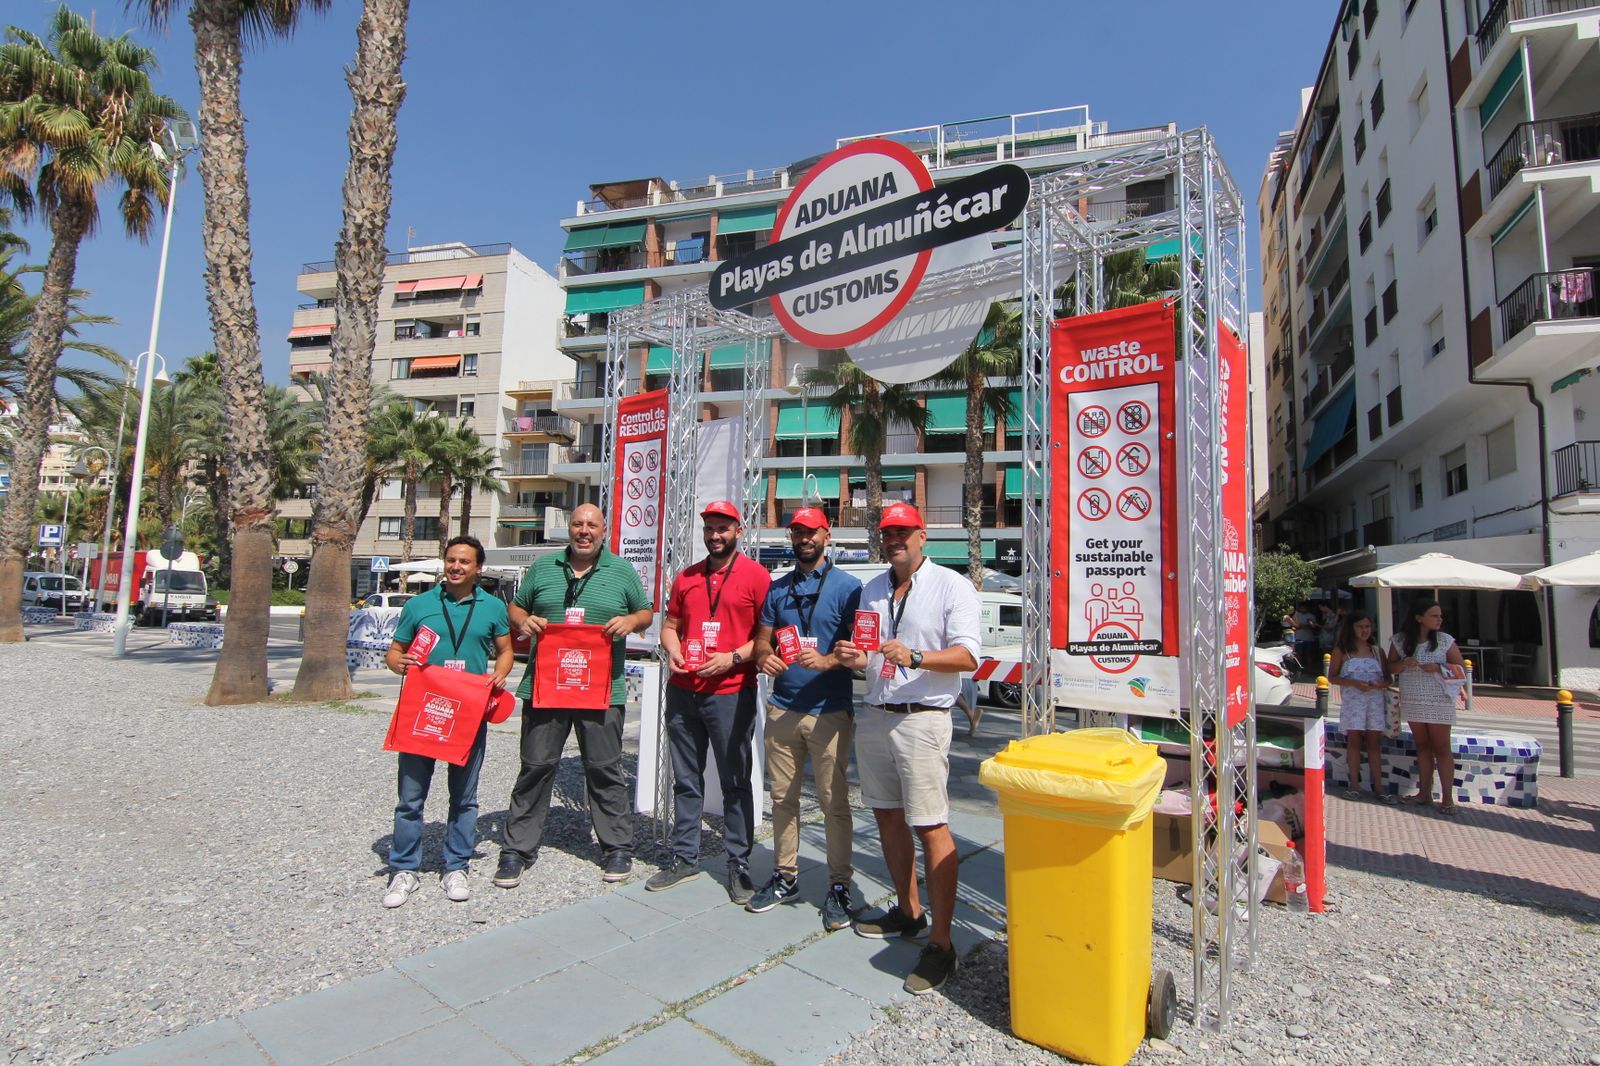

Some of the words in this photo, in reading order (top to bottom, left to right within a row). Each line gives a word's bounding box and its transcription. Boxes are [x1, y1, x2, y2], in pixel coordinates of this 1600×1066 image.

[795, 171, 898, 229] ADUANA
[719, 253, 794, 297] Playas
[799, 239, 833, 271] de
[838, 183, 1009, 259] Almuñécar
[792, 268, 900, 317] CUSTOMS
[1080, 340, 1141, 363] waste
[1059, 353, 1164, 384] CONTROL
[620, 409, 654, 425] Control
[654, 407, 665, 420] de
[619, 418, 666, 437] RESIDUOS
[44, 525, 59, 538] P
[622, 537, 649, 546] Consigue
[1085, 538, 1109, 549] Get
[1111, 538, 1143, 554] your
[624, 546, 653, 555] pasaporte
[1075, 551, 1154, 563] sustainable
[623, 554, 653, 563] sostenible
[1085, 565, 1146, 579] passport
[1096, 632, 1129, 640] ADUANA
[1070, 644, 1098, 654] Playas
[1099, 643, 1111, 652] de
[1111, 642, 1158, 652] Almuñécar
[1097, 656, 1131, 664] CUSTOMS
[425, 702, 454, 715] ADUANA
